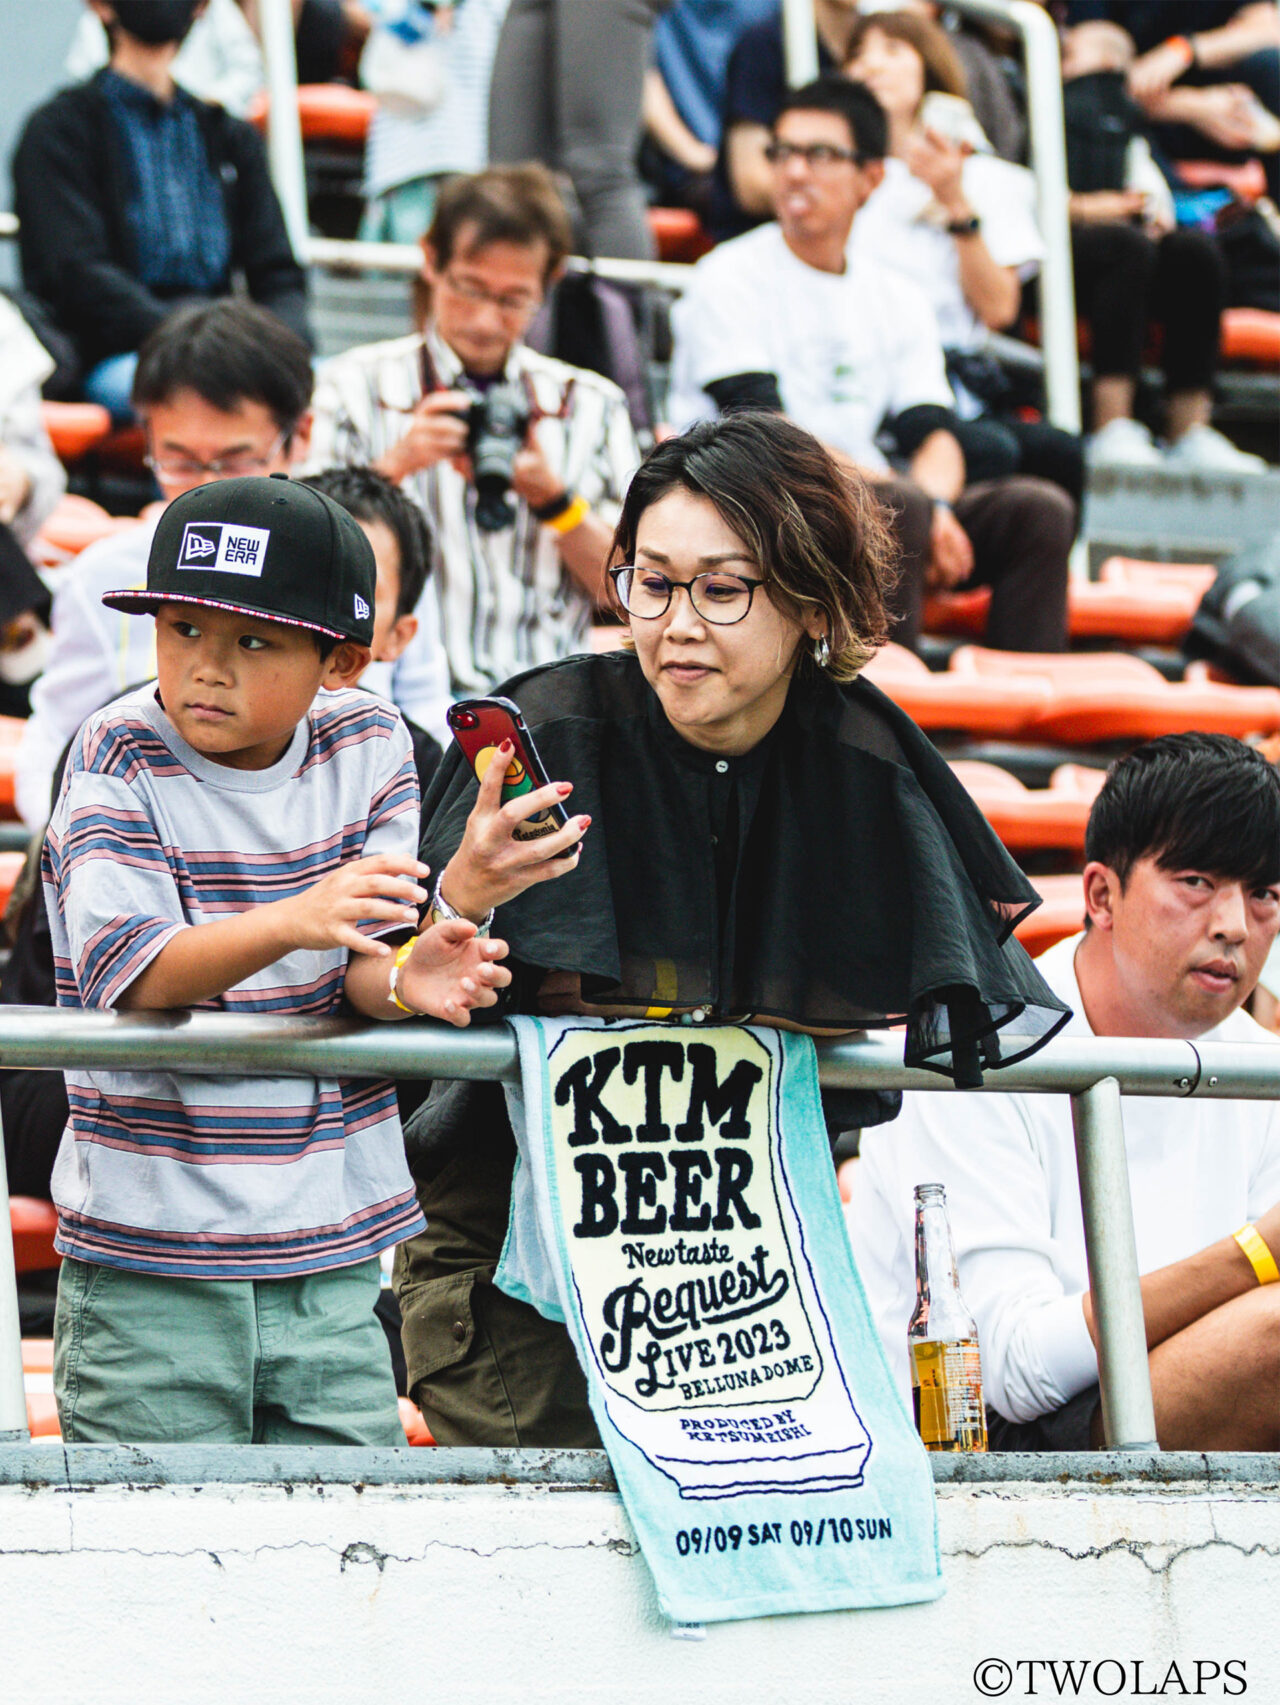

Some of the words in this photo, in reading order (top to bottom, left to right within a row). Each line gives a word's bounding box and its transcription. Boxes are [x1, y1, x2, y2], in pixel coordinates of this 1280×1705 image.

[224, 549, 257, 565] ERA
[227, 535, 260, 551] NEW
[555, 1040, 764, 1147] KTM
[573, 1147, 762, 1238] BEER
[600, 1245, 789, 1373] Request
[717, 1319, 791, 1364] 2023
[679, 1416, 774, 1430] PRODUCED
[772, 1409, 796, 1425] BY
[676, 1524, 743, 1556] 09/09
[748, 1522, 782, 1546] SAT
[790, 1517, 853, 1547] 09/10
[855, 1518, 892, 1541] SUN
